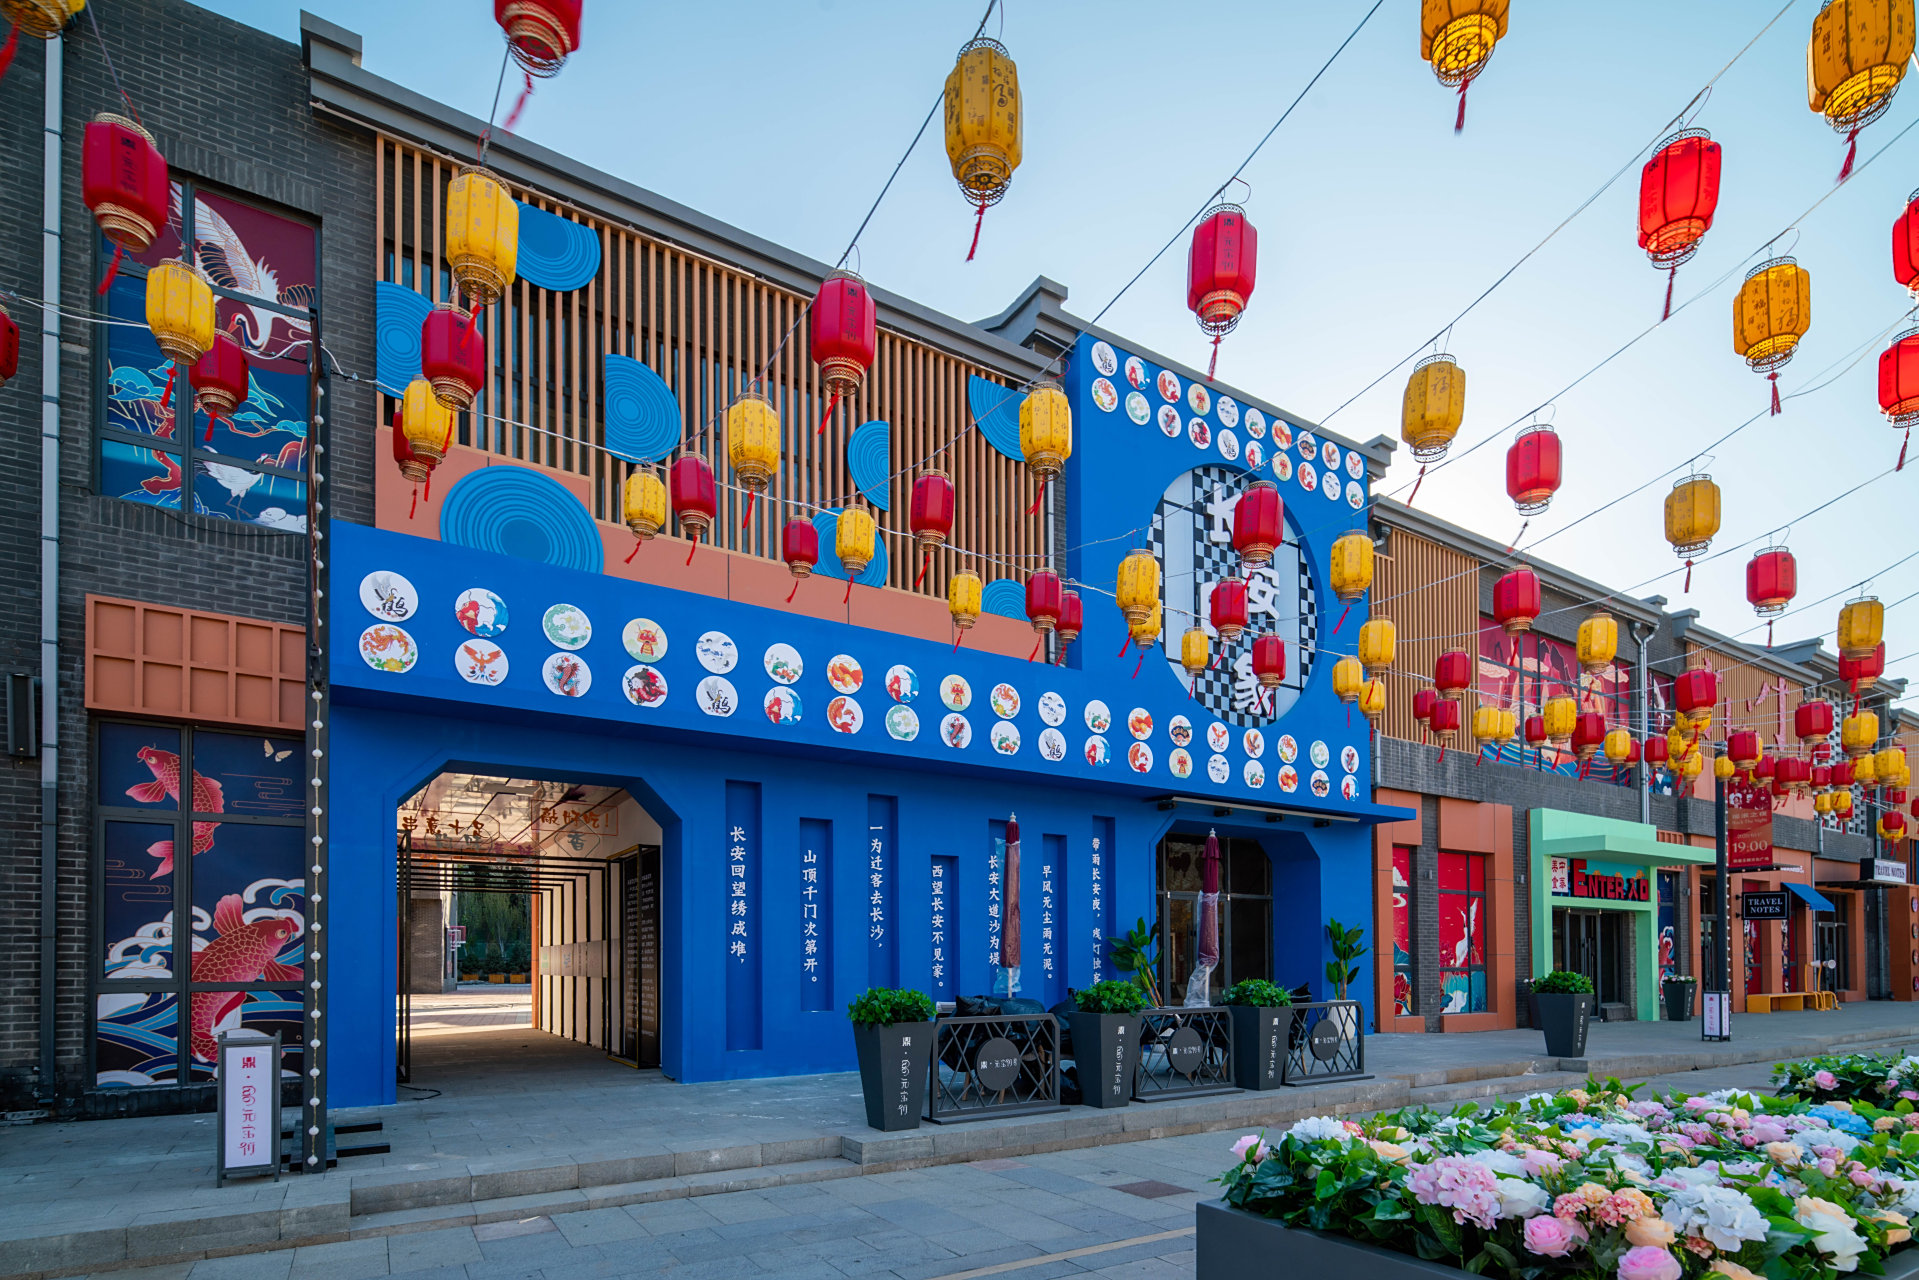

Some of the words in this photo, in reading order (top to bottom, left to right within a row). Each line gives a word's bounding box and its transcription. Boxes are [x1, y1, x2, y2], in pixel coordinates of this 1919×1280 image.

[730, 825, 748, 964] 长安回望绣成堆，
[869, 826, 884, 948] 一为迁客去长沙，
[1732, 840, 1768, 853] 19:00
[1747, 898, 1783, 906] TRAVEL
[802, 849, 819, 983] 山顶千门次第开。
[931, 865, 945, 987] 西望长安不见家。
[1750, 906, 1781, 914] NOTES
